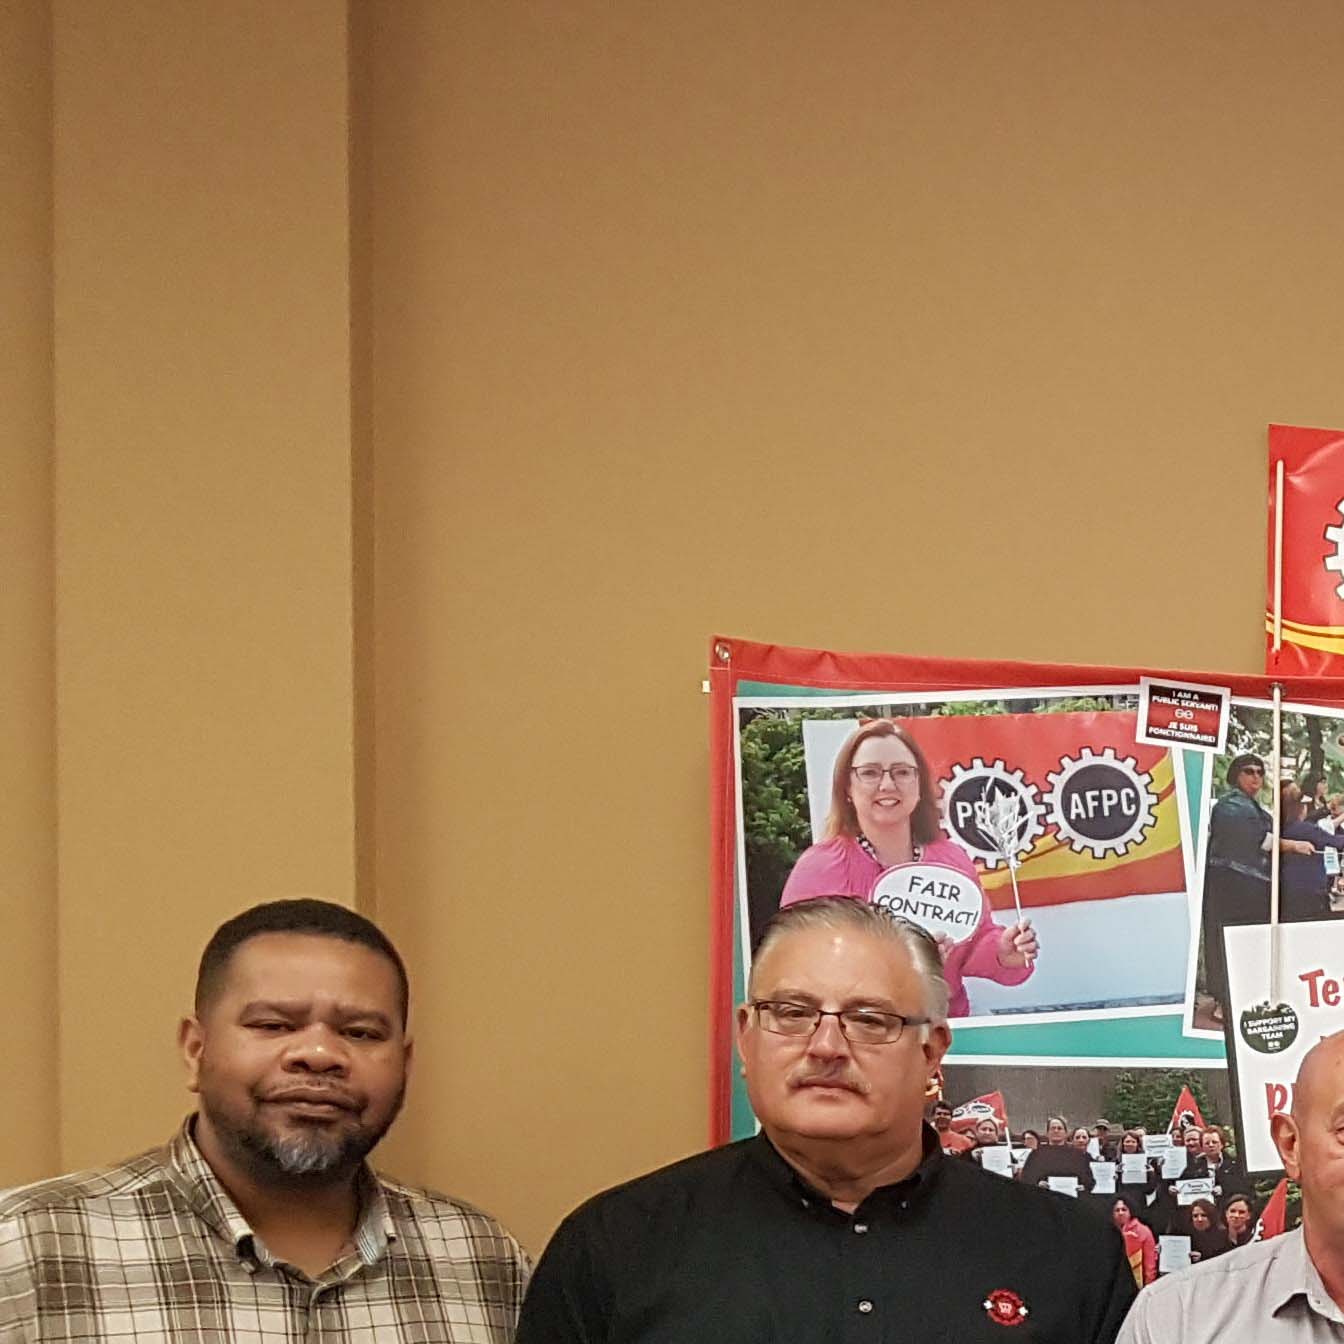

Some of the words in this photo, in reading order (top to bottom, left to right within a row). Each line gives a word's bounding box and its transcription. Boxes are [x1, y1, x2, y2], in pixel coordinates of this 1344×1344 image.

[1069, 787, 1137, 821] AFPC
[908, 876, 961, 902] FAIR
[877, 895, 980, 927] CONTRACT!
